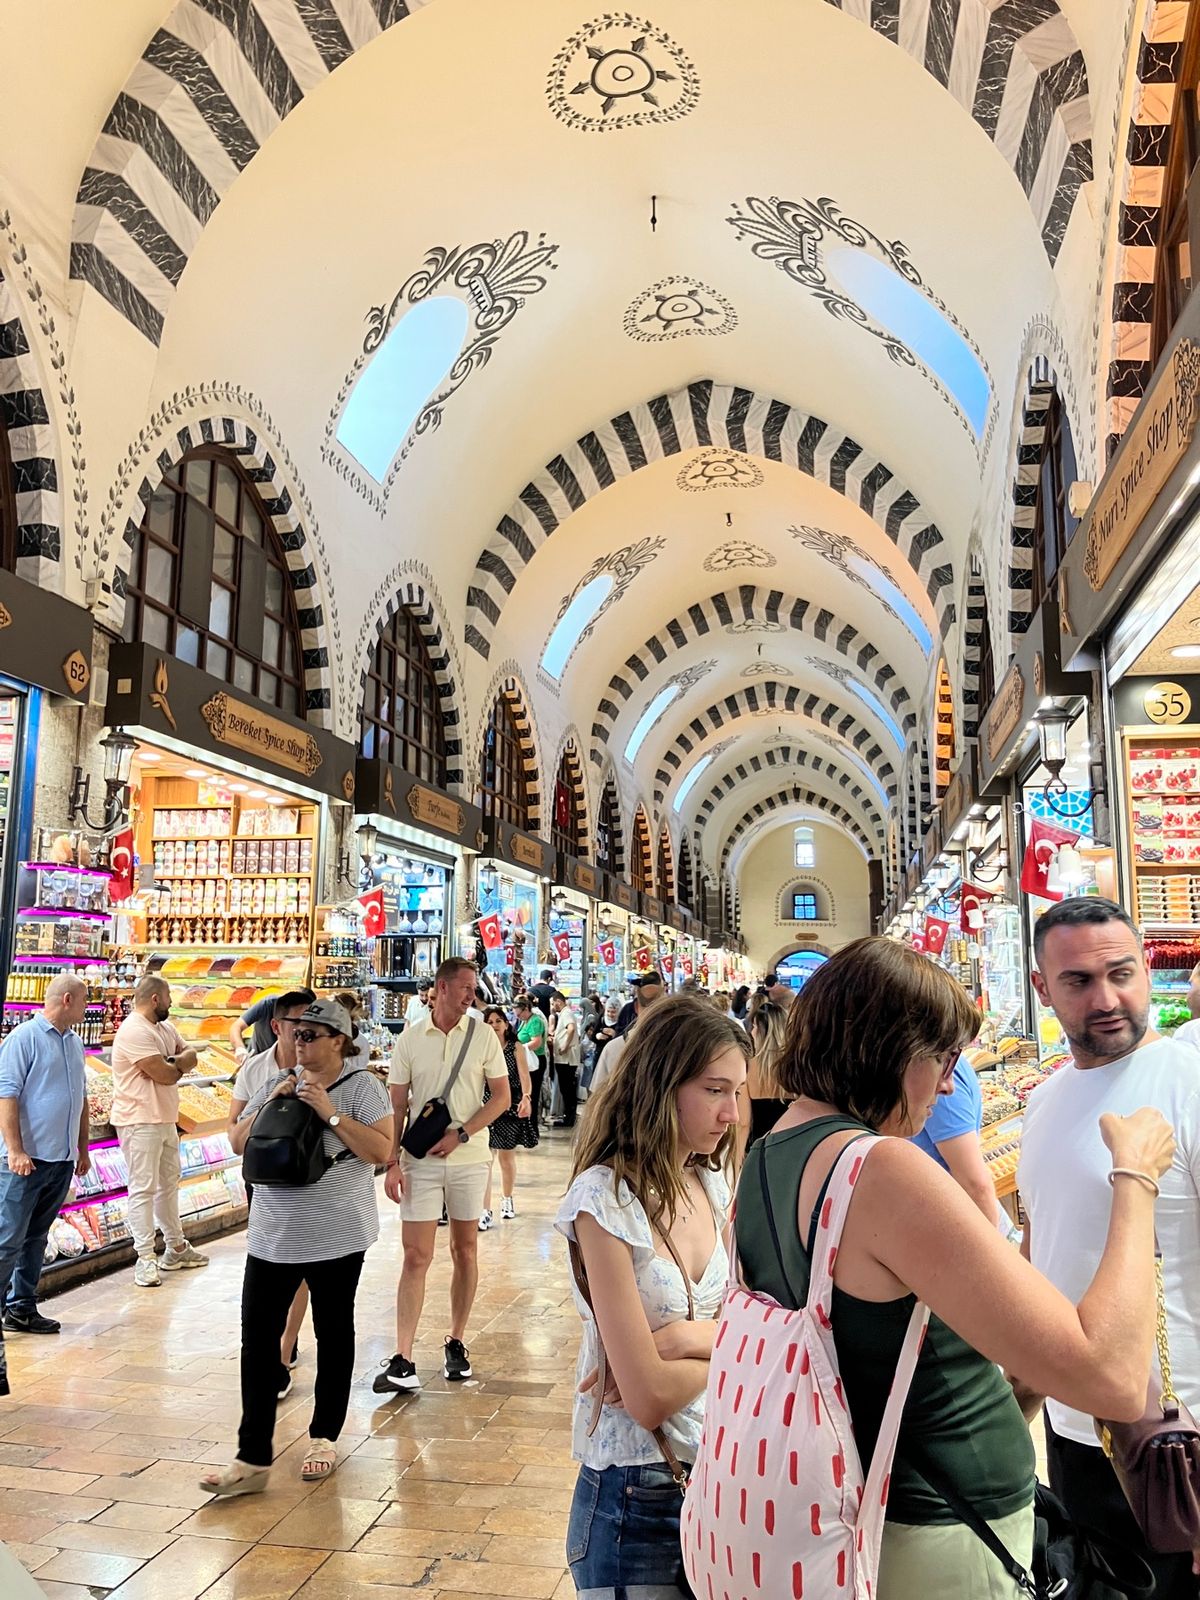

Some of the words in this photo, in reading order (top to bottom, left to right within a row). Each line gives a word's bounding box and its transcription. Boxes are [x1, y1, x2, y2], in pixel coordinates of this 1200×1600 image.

[1098, 487, 1119, 551] Nuri
[1120, 453, 1144, 521] Spice
[1146, 397, 1173, 466] Shop
[70, 660, 85, 683] 62
[1152, 692, 1184, 717] 55
[228, 713, 262, 741] Bereket
[263, 728, 285, 750] Spice
[287, 737, 305, 763] Shop
